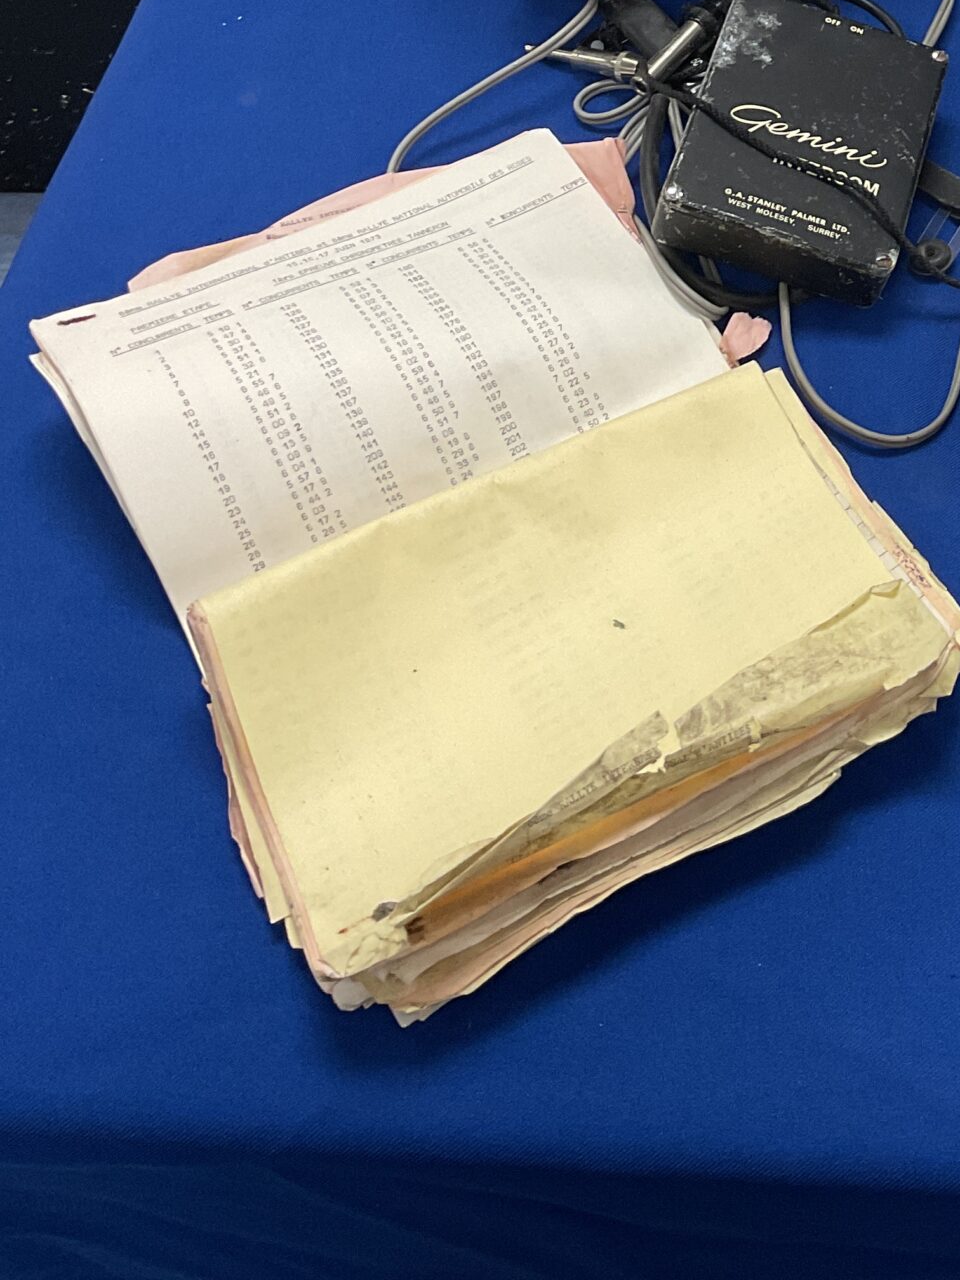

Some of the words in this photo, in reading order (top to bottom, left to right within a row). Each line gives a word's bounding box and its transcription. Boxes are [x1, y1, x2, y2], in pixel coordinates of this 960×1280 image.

[825, 17, 841, 27] OFF
[850, 25, 864, 35] ON
[730, 104, 887, 168] Gemini
[560, 176, 586, 192] TEMPS
[356, 218, 389, 235] RALLYE
[392, 201, 433, 222] NATIONAL
[436, 177, 485, 204] AUTOMOBILE
[727, 197, 752, 211] WEST
[791, 209, 826, 227] PALMER
[832, 222, 851, 235] LTD.
[381, 239, 439, 264] CONCURRENTS
[447, 226, 474, 241] TEMPS
[320, 358, 338, 370] 133
[325, 367, 343, 379] 135
[335, 386, 351, 399] 137
[182, 409, 195, 419] 10
[187, 419, 200, 429] 12
[198, 440, 211, 451] 15
[267, 408, 280, 419] 51
[499, 421, 517, 436] 200
[192, 430, 205, 440] 14
[361, 439, 378, 451] 141
[437, 416, 448, 427] 51
[504, 432, 521, 446] 201
[509, 442, 527, 456] 202
[208, 461, 219, 472] 17
[375, 470, 394, 484] 143
[218, 484, 231, 495] 19
[385, 492, 403, 505] 145
[227, 506, 241, 518] 23
[233, 518, 246, 529] 24
[317, 515, 329, 525] 17
[238, 528, 251, 540] 25
